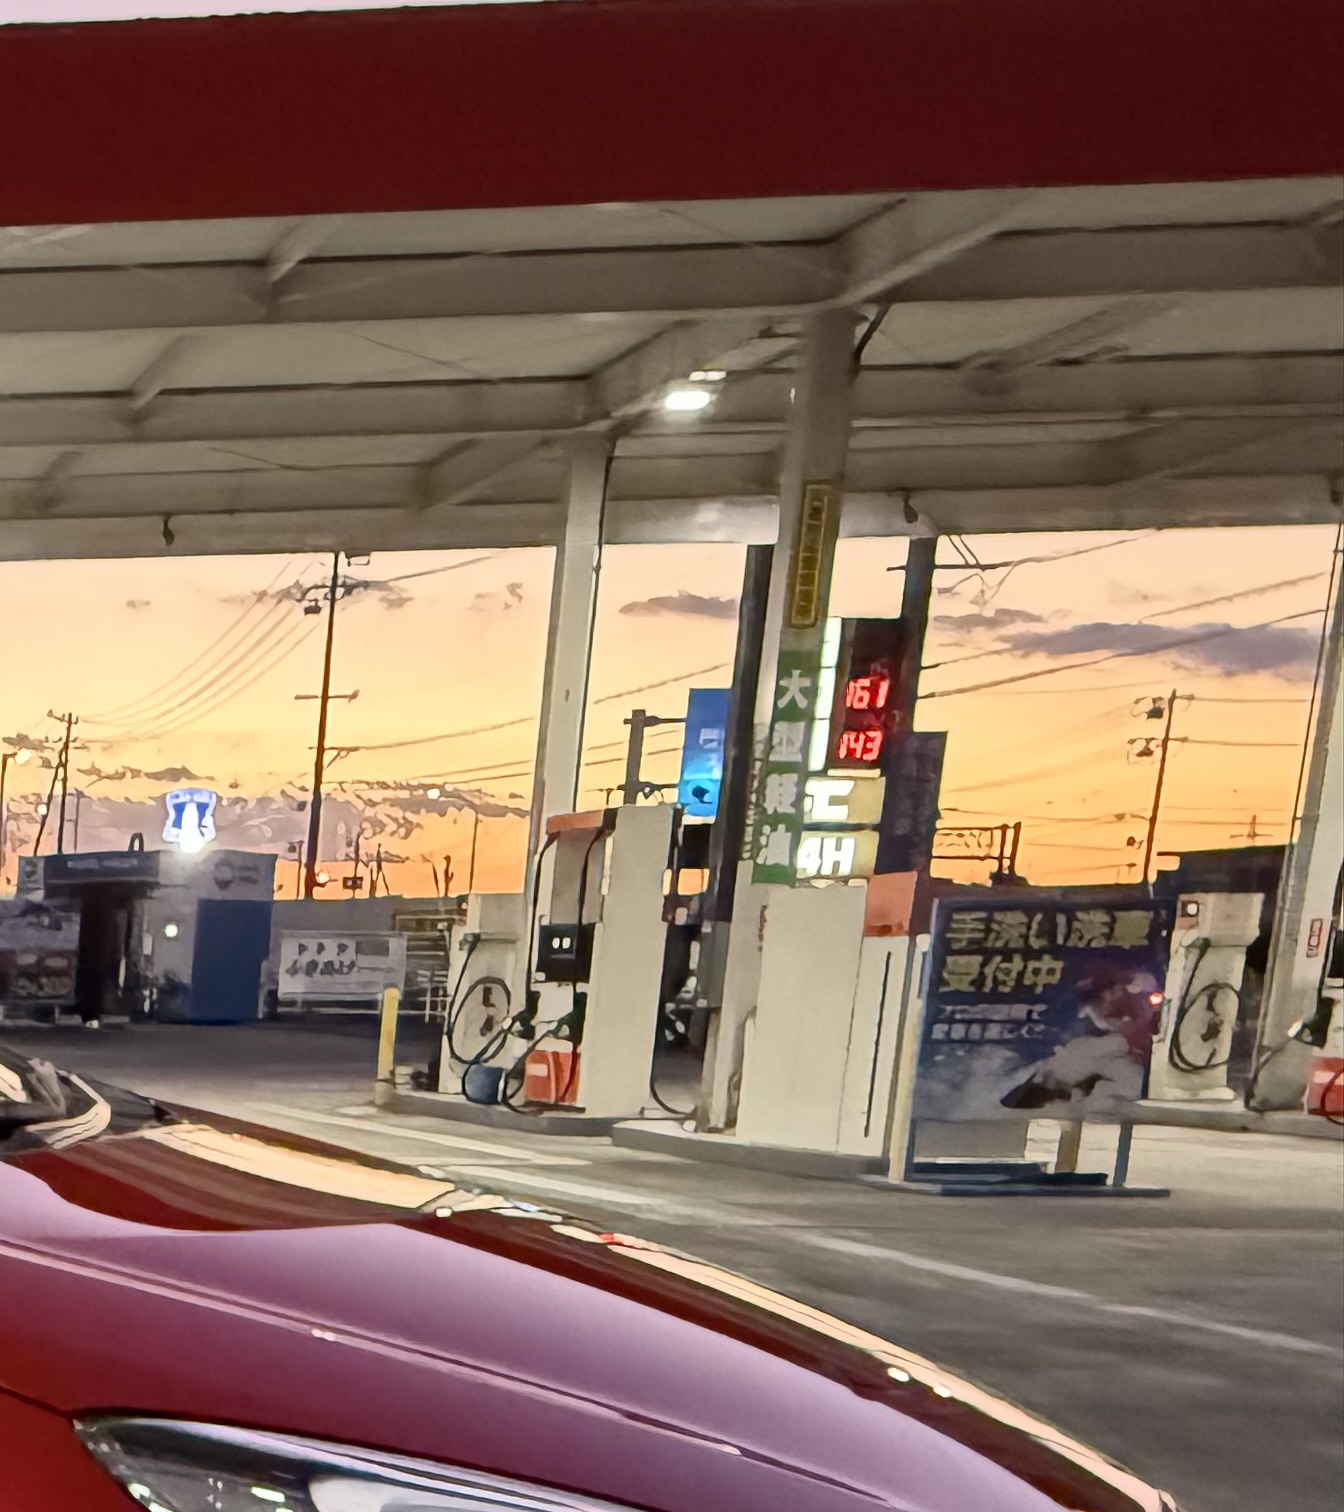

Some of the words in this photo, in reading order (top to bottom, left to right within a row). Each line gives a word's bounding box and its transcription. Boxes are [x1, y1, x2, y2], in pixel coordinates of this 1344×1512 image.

[845, 677, 891, 710] 161
[838, 729, 885, 762] 143
[938, 953, 1066, 995] 受付中
